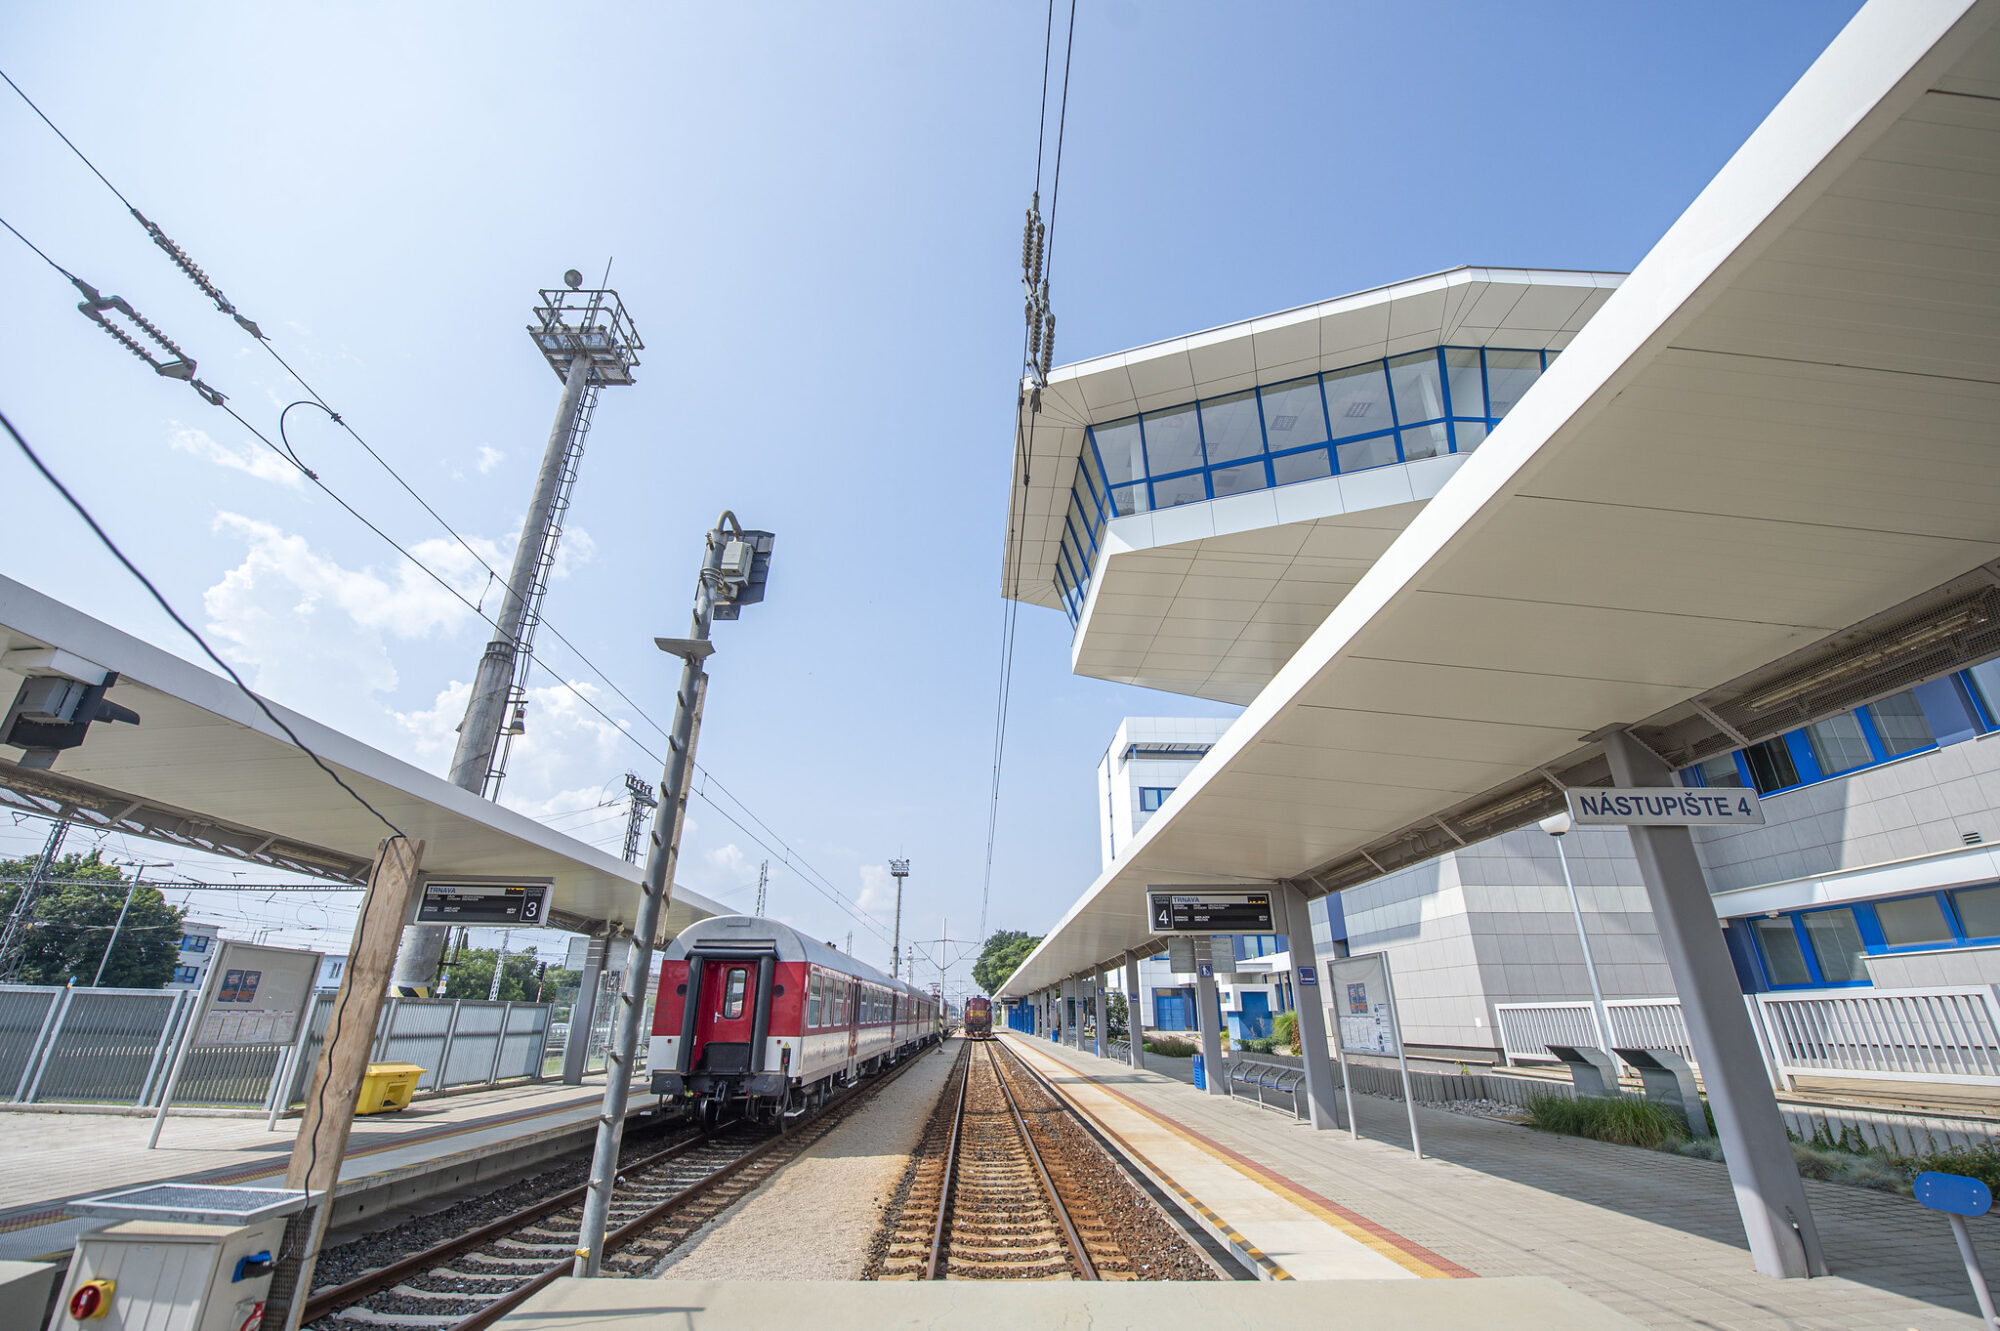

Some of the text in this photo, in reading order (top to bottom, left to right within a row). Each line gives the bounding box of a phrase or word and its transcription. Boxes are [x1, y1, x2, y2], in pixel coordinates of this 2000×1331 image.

[1579, 791, 1751, 816] NÁSTUPIŠTE 4
[525, 901, 537, 918] 3
[1158, 909, 1169, 925] 4
